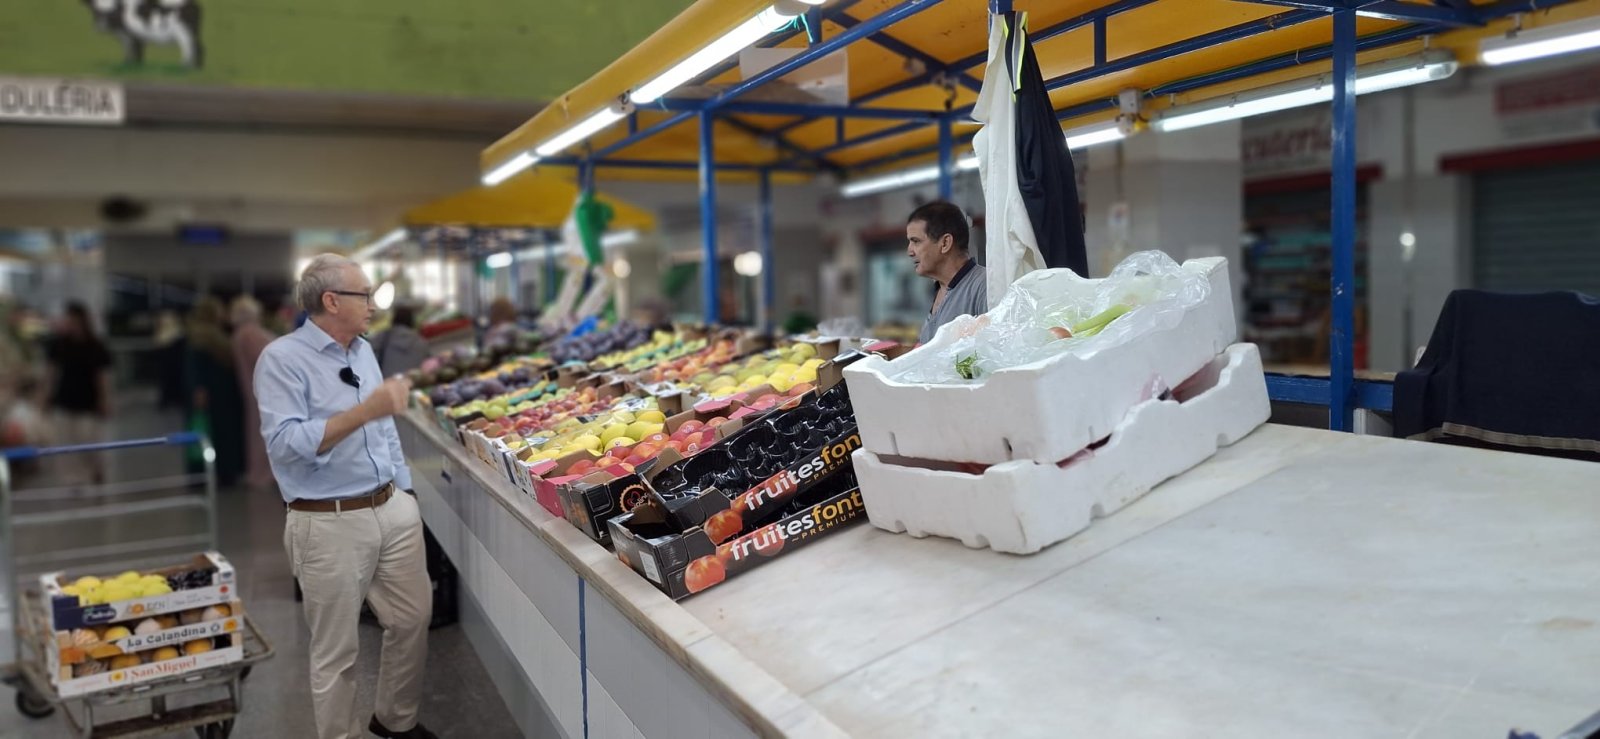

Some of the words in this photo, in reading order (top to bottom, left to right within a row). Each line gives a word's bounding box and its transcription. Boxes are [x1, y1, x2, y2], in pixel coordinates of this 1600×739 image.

[744, 433, 862, 511] fruitesfon
[813, 456, 849, 480] PREMI
[730, 491, 863, 561] fruitesfont
[801, 511, 856, 540] PREMIUM
[127, 637, 142, 648] La
[146, 625, 206, 644] Calandina
